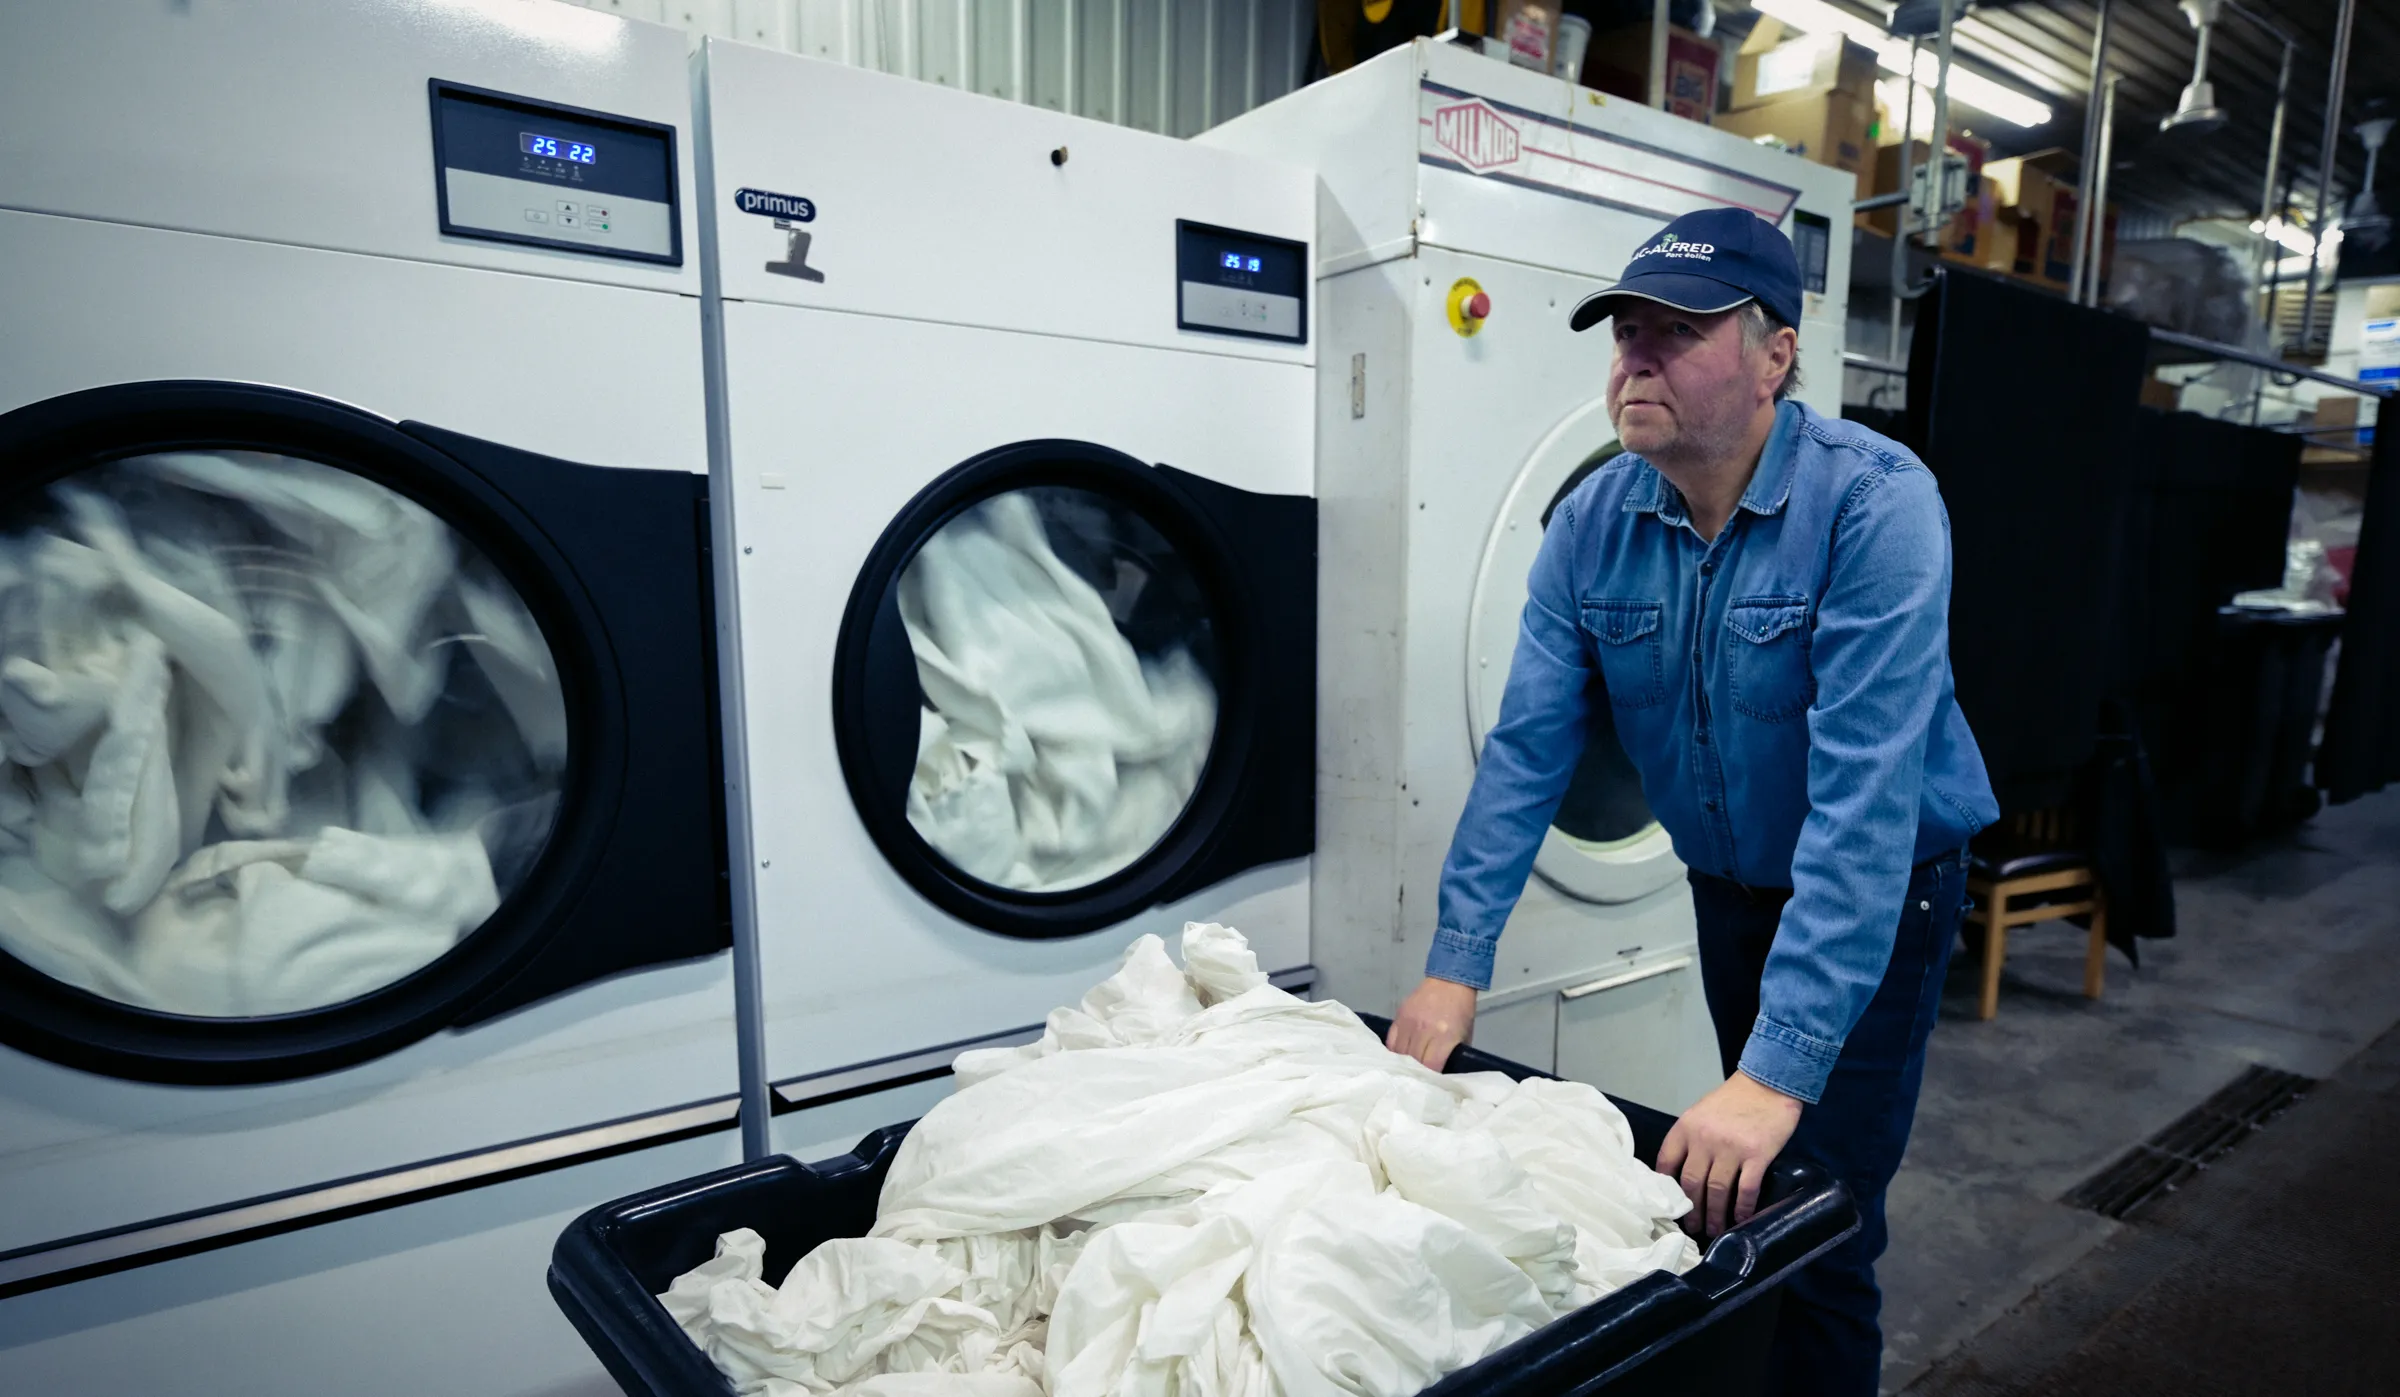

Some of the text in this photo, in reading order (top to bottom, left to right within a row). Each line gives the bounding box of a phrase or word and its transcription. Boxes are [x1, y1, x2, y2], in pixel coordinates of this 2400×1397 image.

[1440, 107, 1517, 166] MILNOR
[532, 137, 593, 163] 25 22
[744, 192, 809, 217] primus
[1225, 253, 1240, 269] 25
